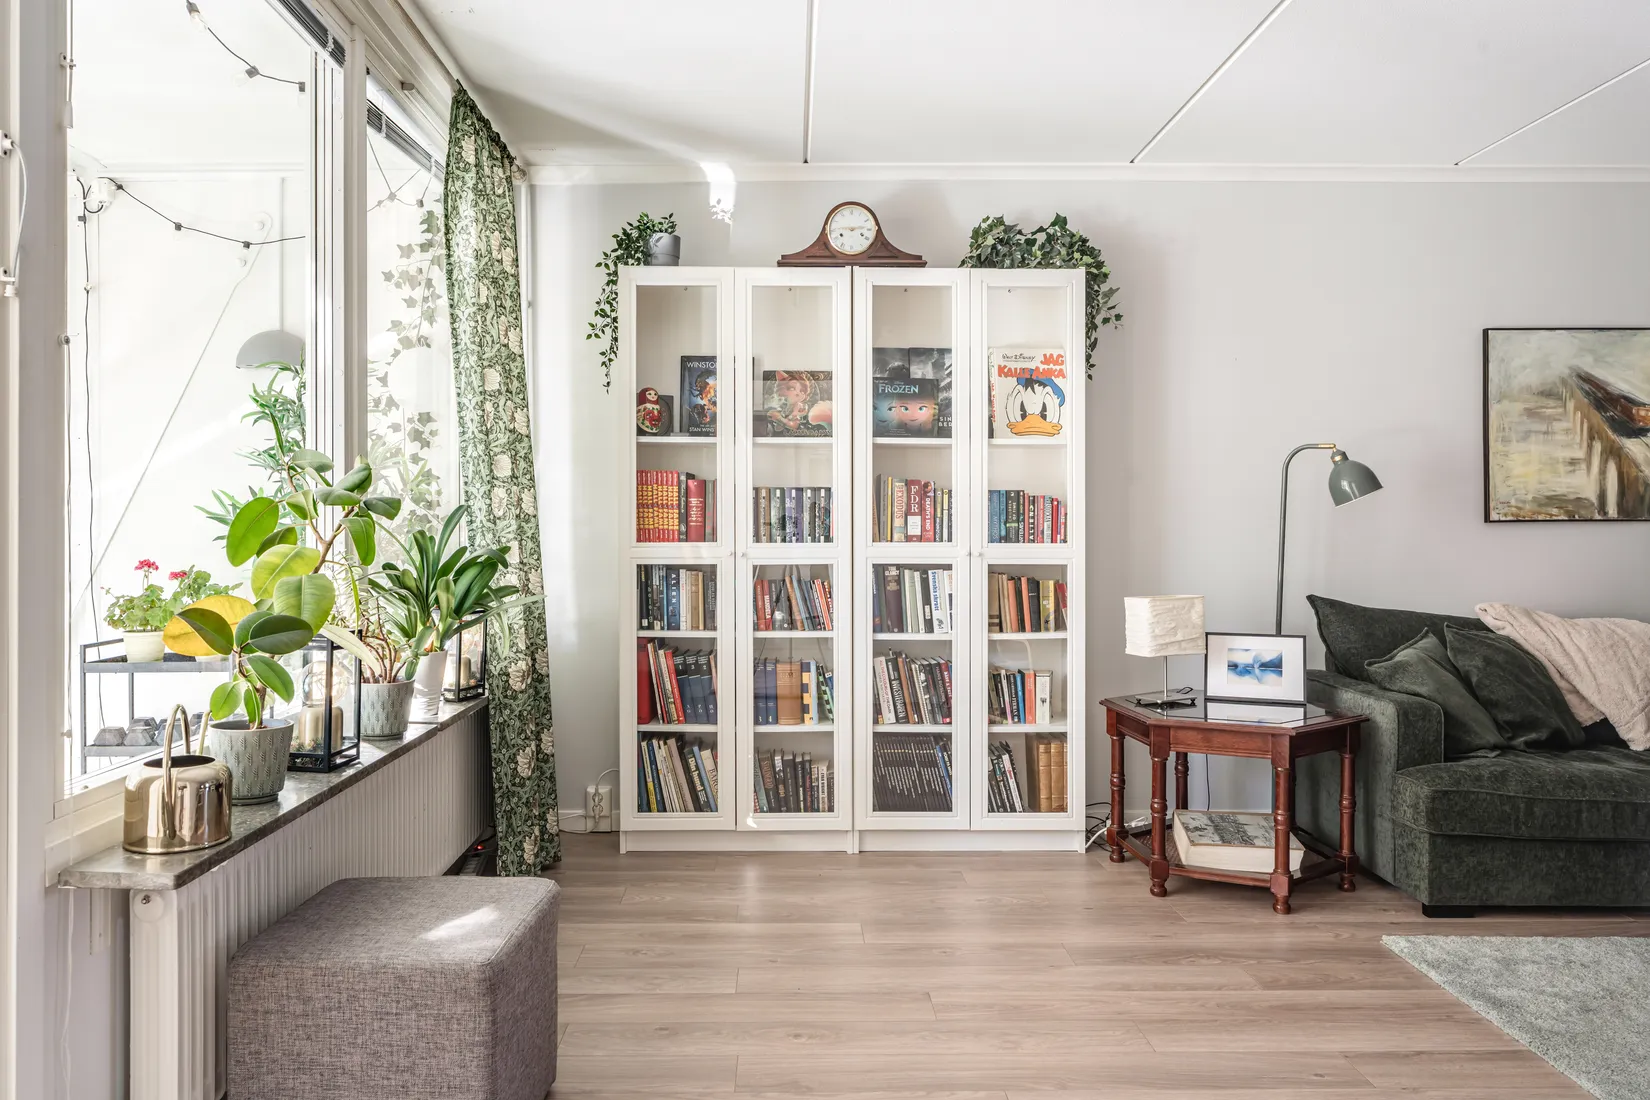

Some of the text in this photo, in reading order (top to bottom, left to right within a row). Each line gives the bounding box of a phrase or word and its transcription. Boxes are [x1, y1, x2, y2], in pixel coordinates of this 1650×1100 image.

[1040, 353, 1064, 366] JAG
[998, 364, 1066, 379] KALLE ANKA
[879, 384, 919, 393] FROZEN
[693, 771, 703, 791] hund
